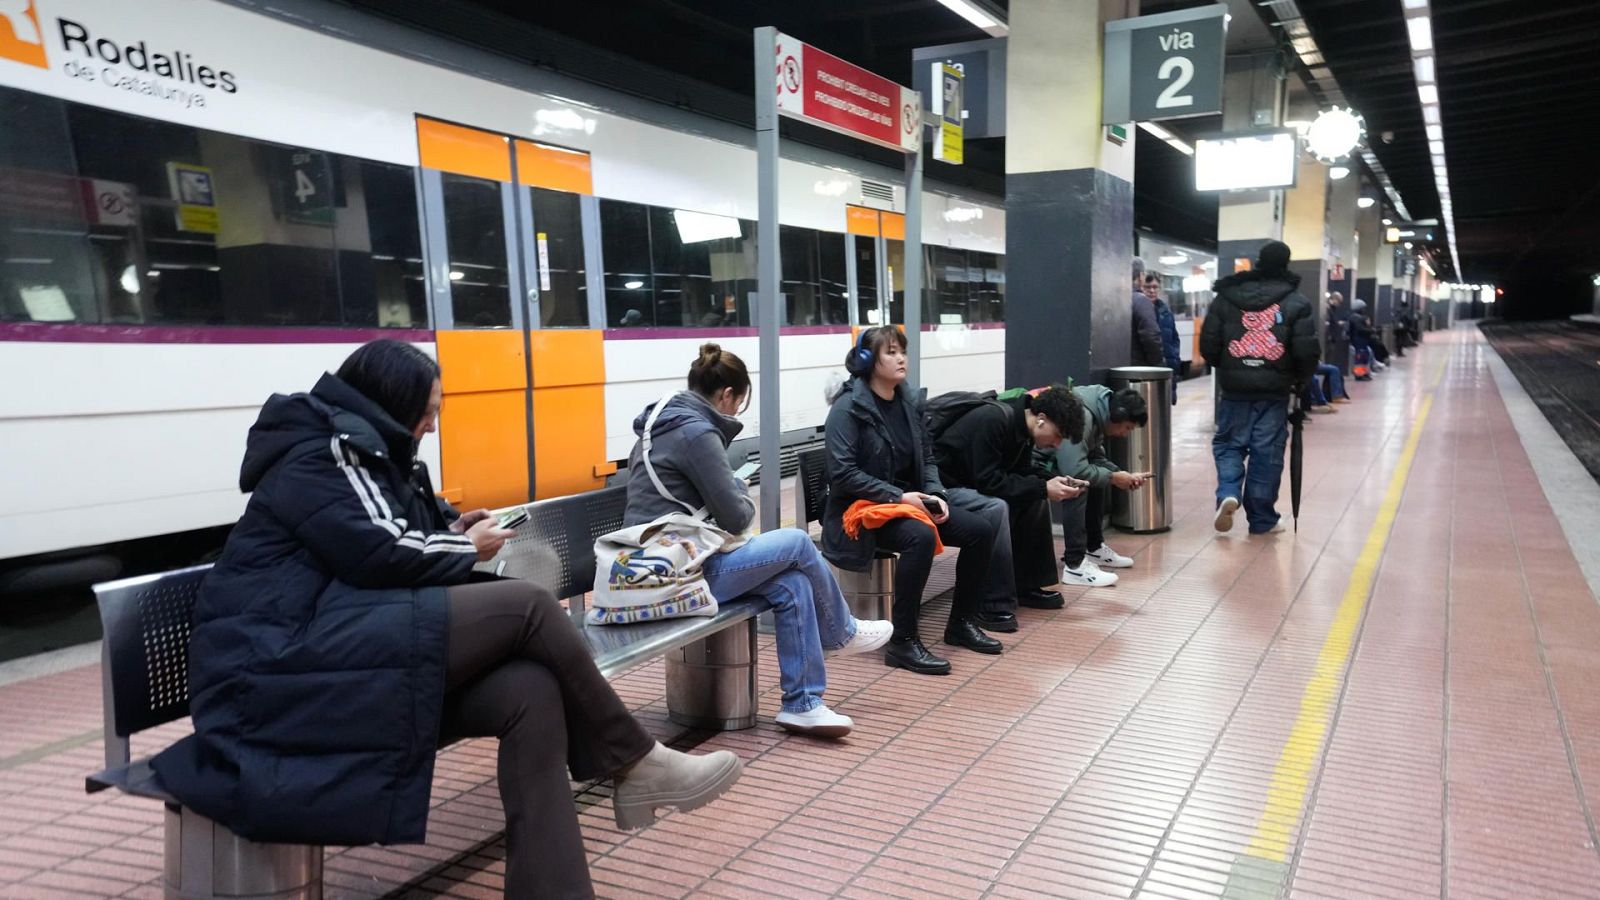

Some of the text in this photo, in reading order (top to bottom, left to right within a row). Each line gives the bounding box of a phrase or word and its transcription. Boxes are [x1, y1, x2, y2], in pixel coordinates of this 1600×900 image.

[58, 18, 238, 94] Rodalies
[1159, 28, 1195, 52] via
[64, 60, 206, 109] de Catalunya
[1155, 56, 1195, 109] 2
